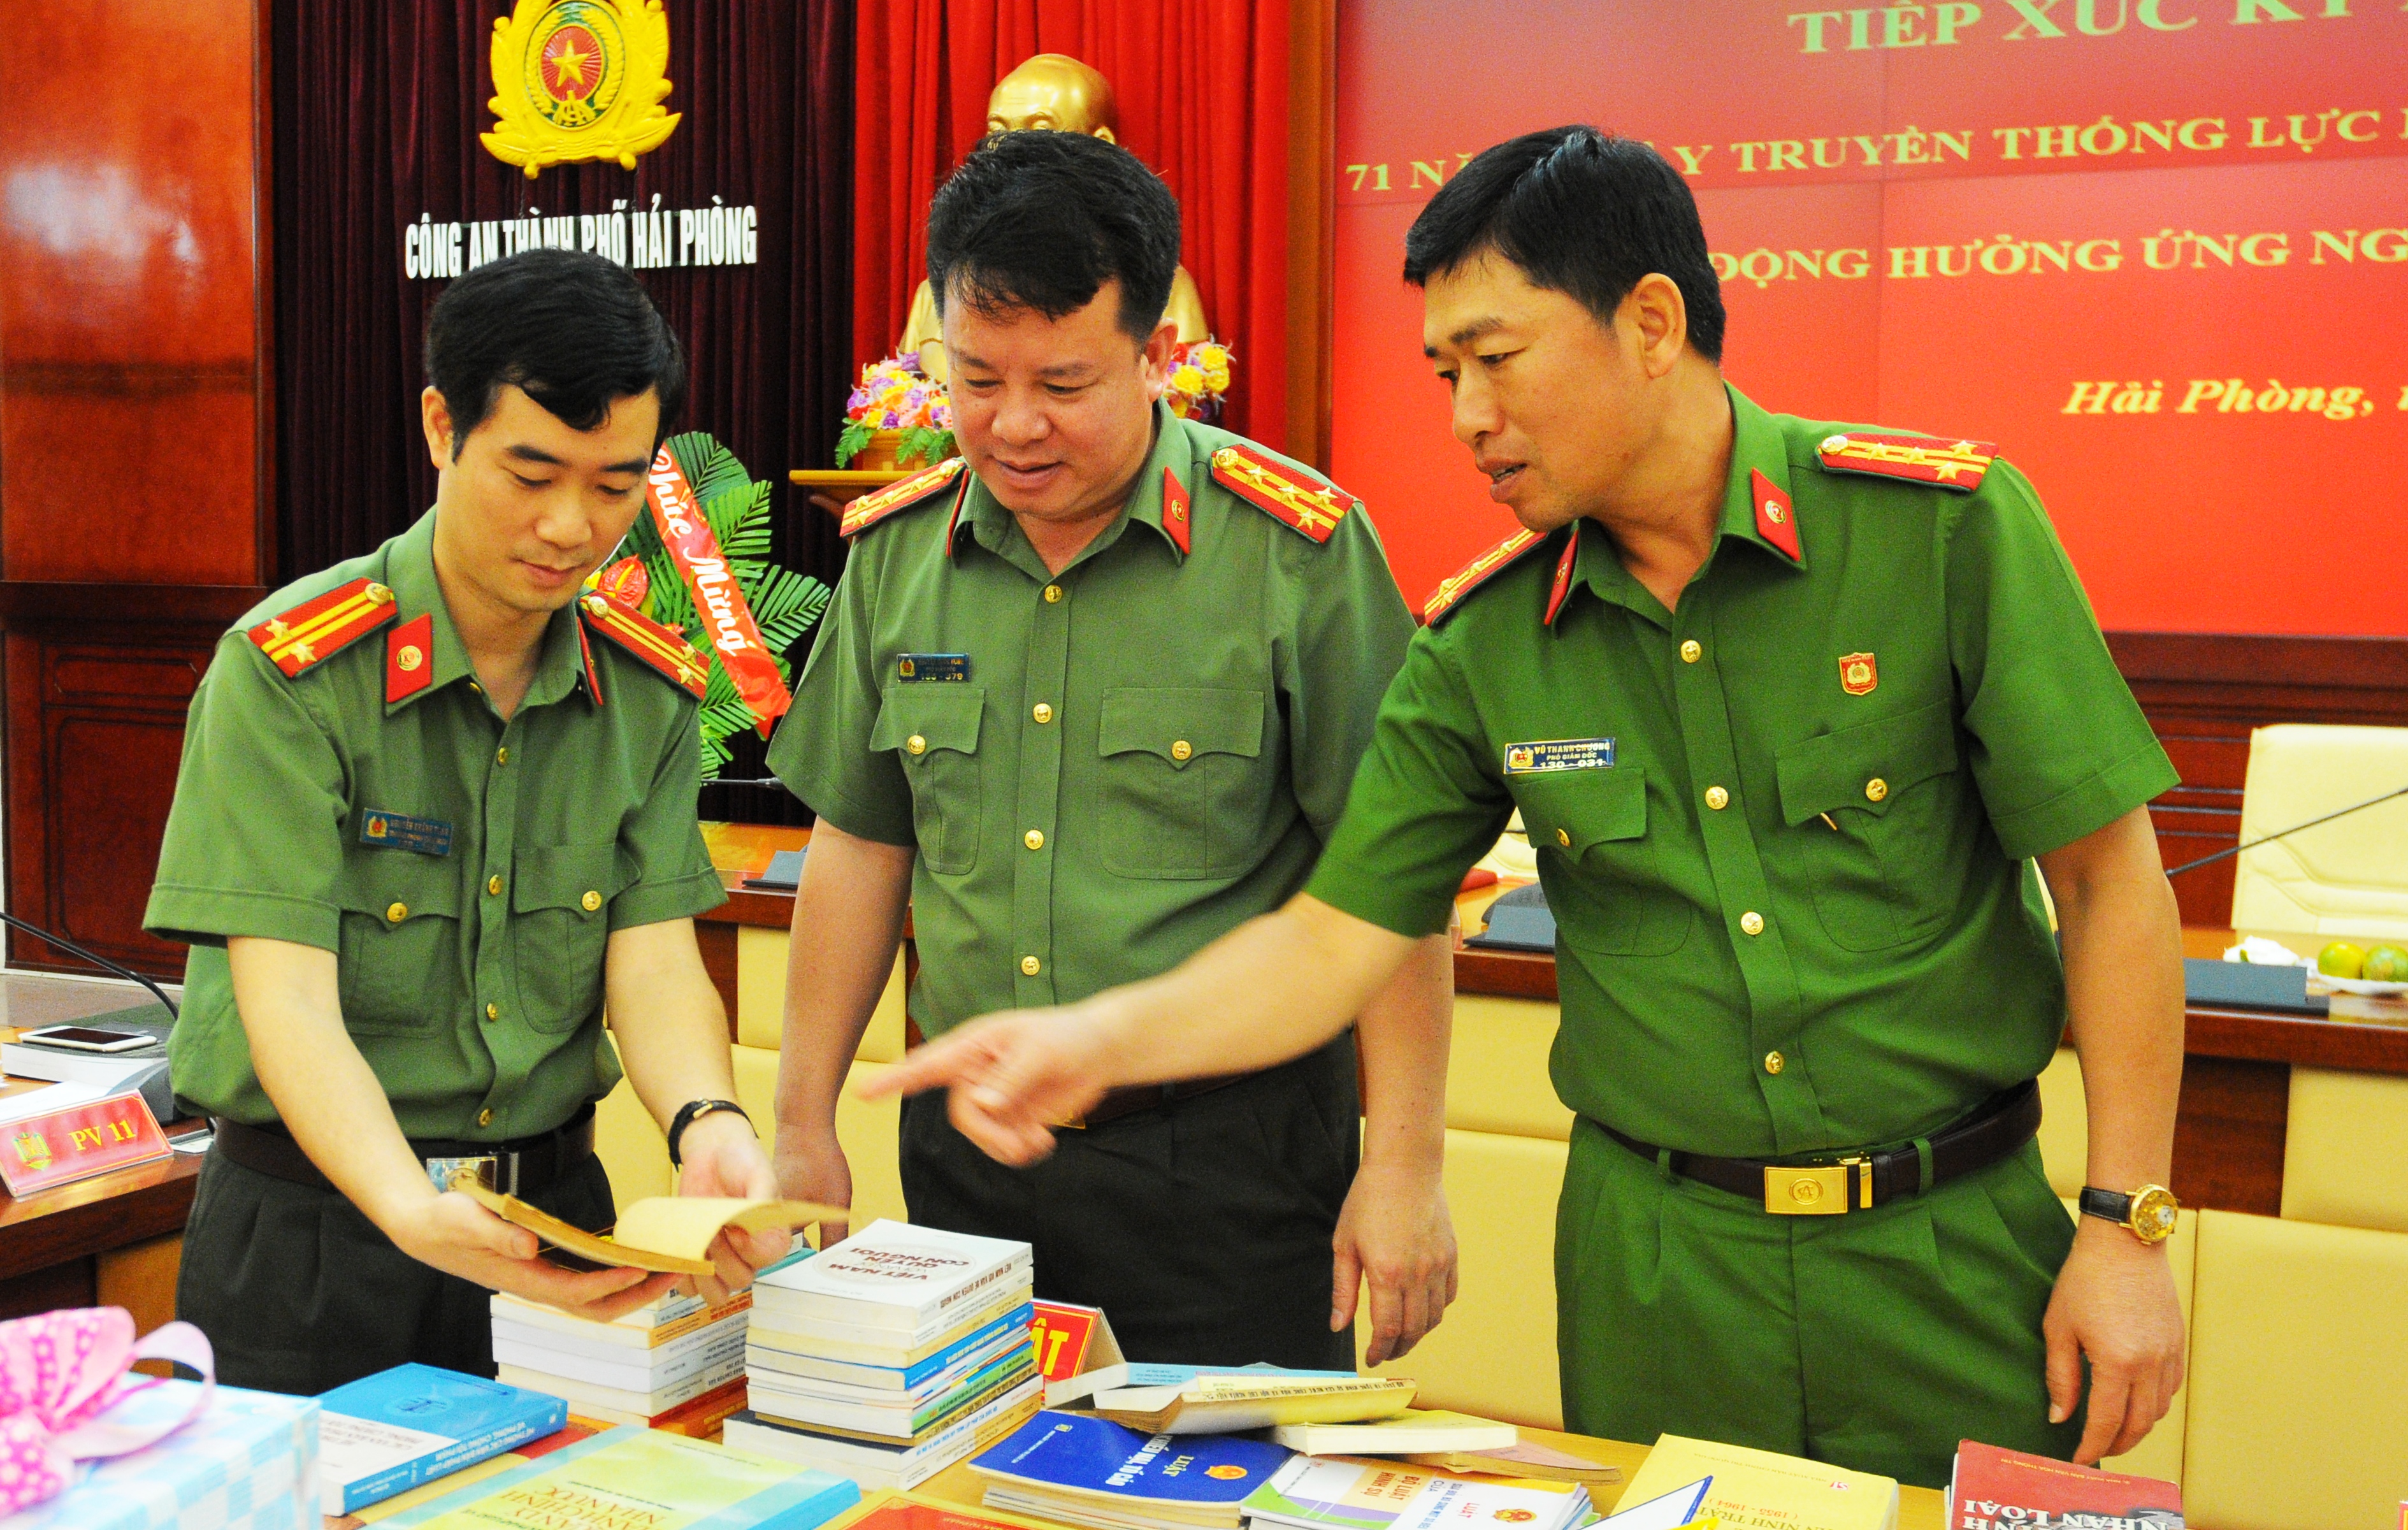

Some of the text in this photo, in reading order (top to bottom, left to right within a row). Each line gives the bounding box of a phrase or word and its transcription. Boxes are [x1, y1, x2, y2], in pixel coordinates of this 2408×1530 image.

[1346, 163, 1391, 191] 71
[1731, 126, 1973, 173] TRUYỀN
[1993, 115, 2229, 159] THỐNG
[2246, 108, 2381, 154] LỰC
[405, 193, 757, 279] CÔNG AN THÀNH PHỐ HẢI PHÒNG
[1888, 233, 2124, 278] HƯỞNG
[2140, 229, 2290, 270] ỨNG
[2059, 379, 2163, 414] Hải
[2175, 378, 2374, 420] Phòng,
[683, 546, 748, 657] Mừng
[68, 1120, 136, 1151] PV 11
[924, 1258, 970, 1266] CON
[1162, 1455, 1195, 1477] LUẬT
[1389, 1475, 1420, 1501] BỘ LUẬT
[1964, 1500, 2049, 1526] LOẠI
